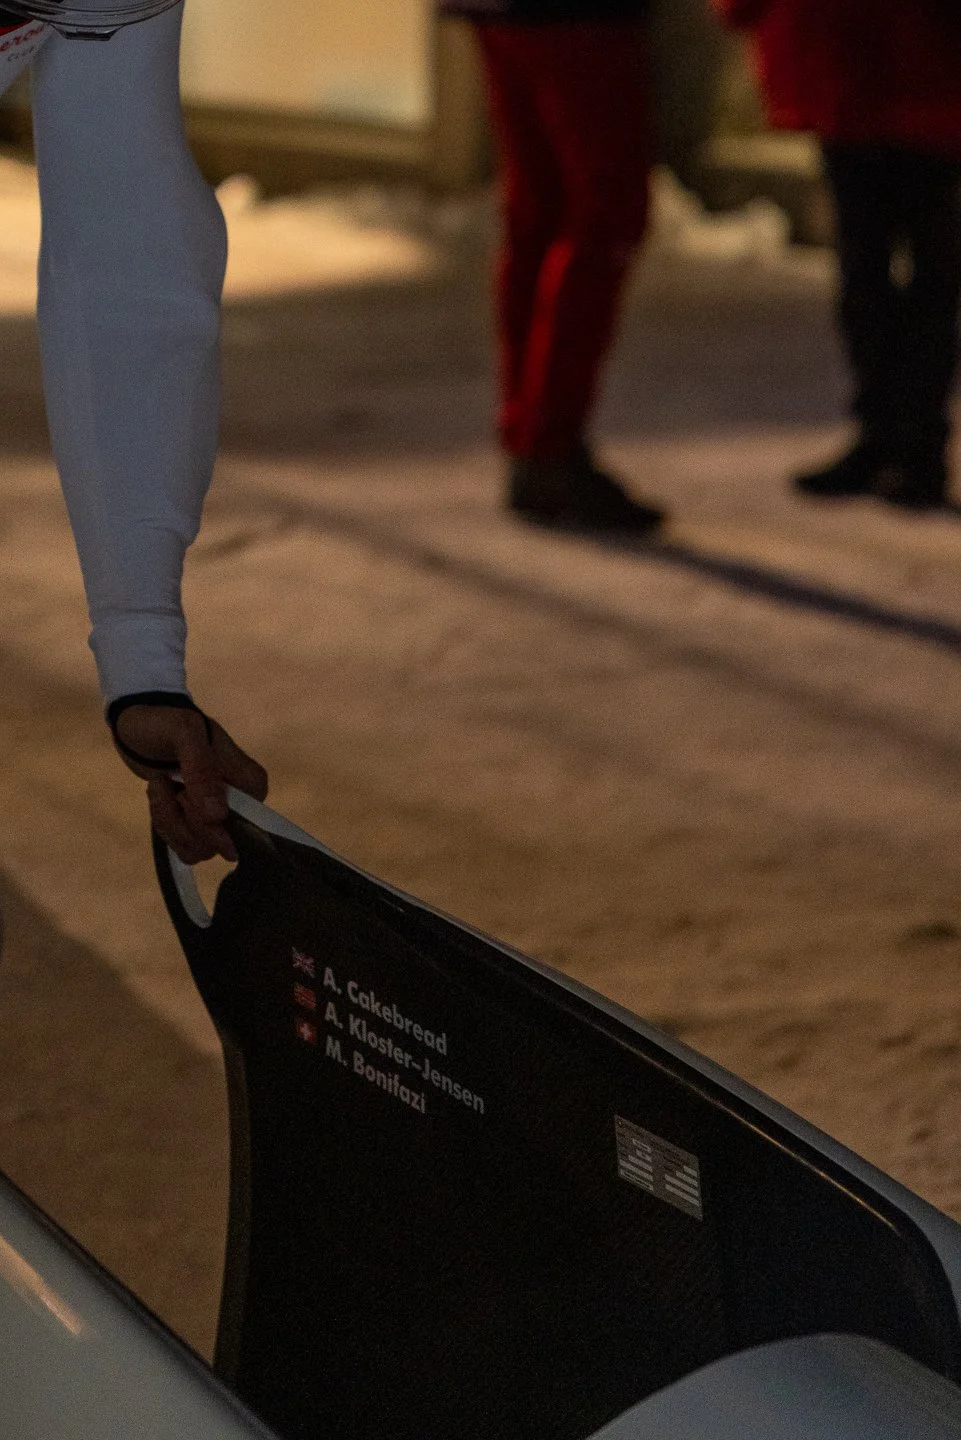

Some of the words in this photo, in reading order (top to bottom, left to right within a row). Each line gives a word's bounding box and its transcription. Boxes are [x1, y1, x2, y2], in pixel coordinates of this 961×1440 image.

[322, 966, 342, 995] A.
[346, 980, 448, 1056] Cakebread
[324, 1001, 344, 1029] A.
[348, 1013, 486, 1115] Kloster-Jensen
[325, 1034, 348, 1067] M.
[352, 1050, 426, 1114] Bonifazi
